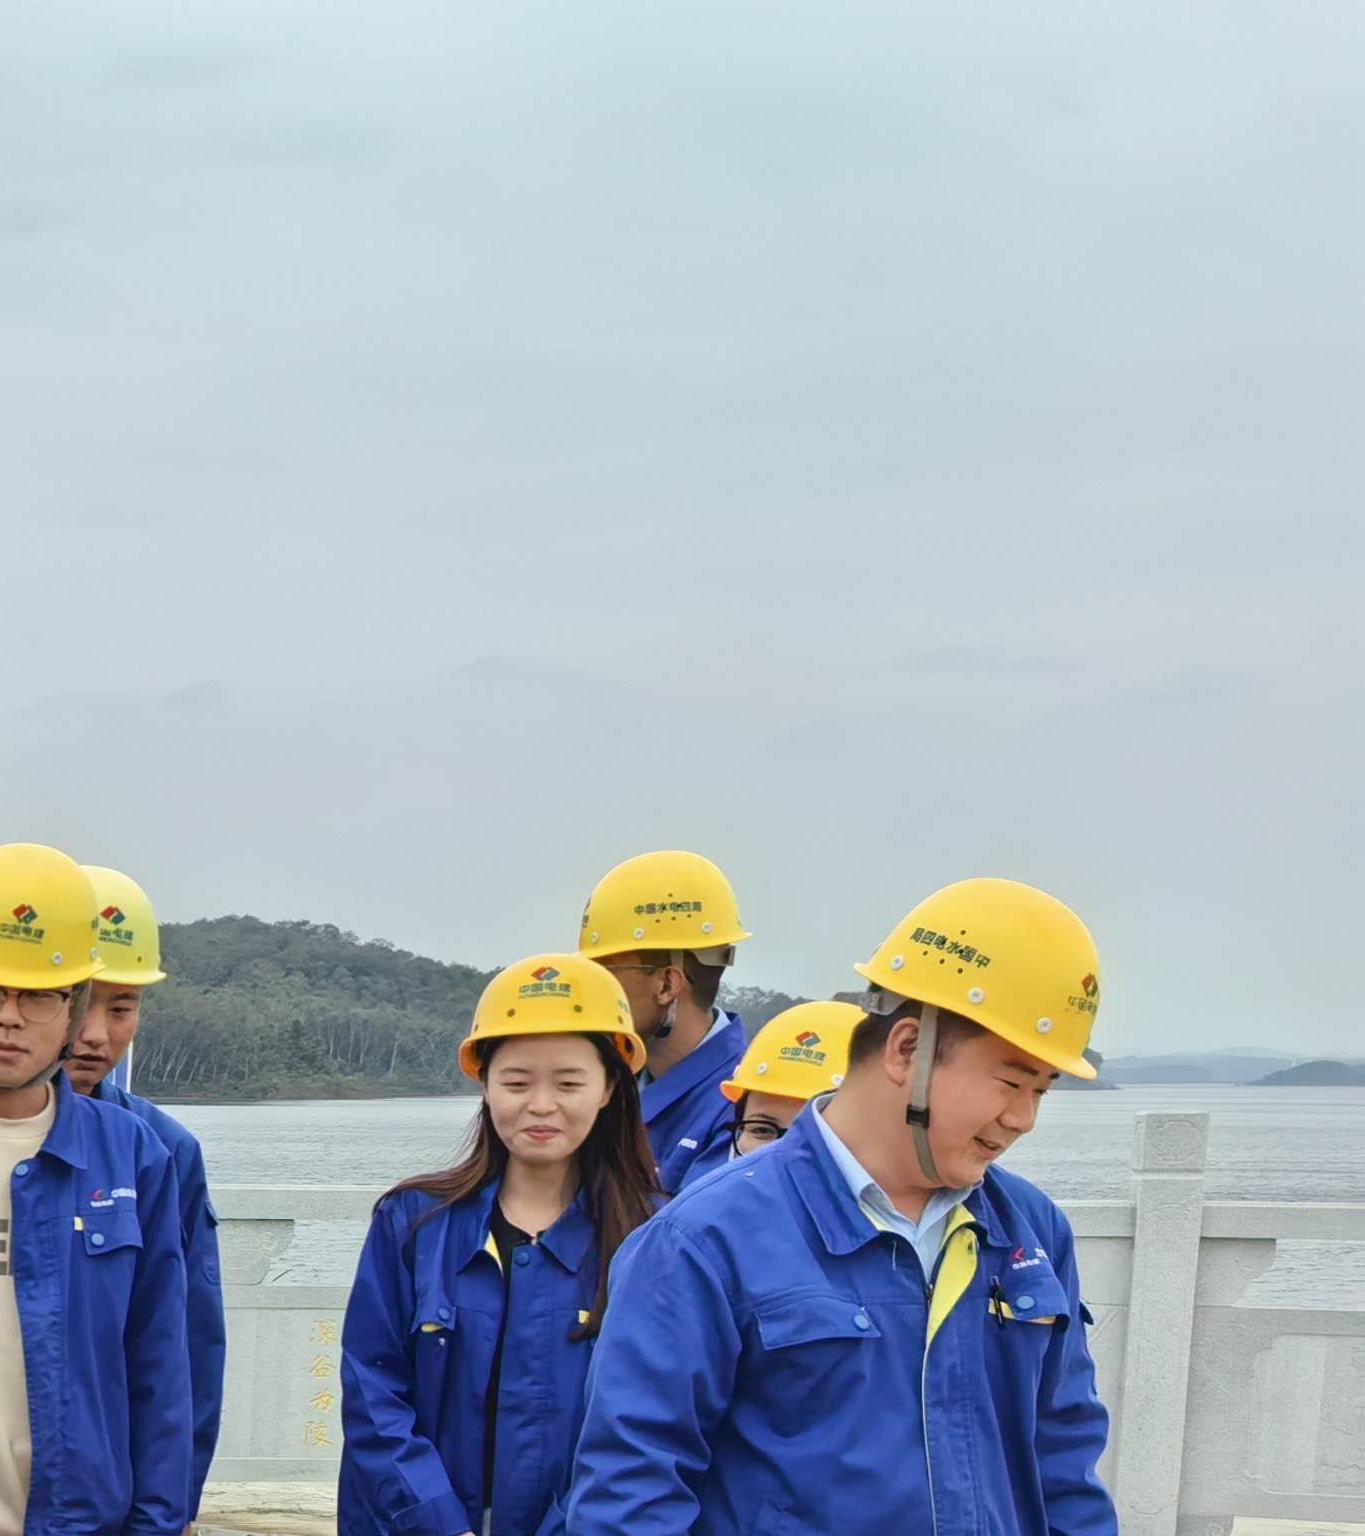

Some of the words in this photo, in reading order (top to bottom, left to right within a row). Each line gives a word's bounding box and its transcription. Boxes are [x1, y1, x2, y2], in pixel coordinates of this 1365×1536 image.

[634, 901, 702, 916] 中国水电四局
[518, 982, 572, 994] 中国电建
[780, 1045, 827, 1062] 中国电建
